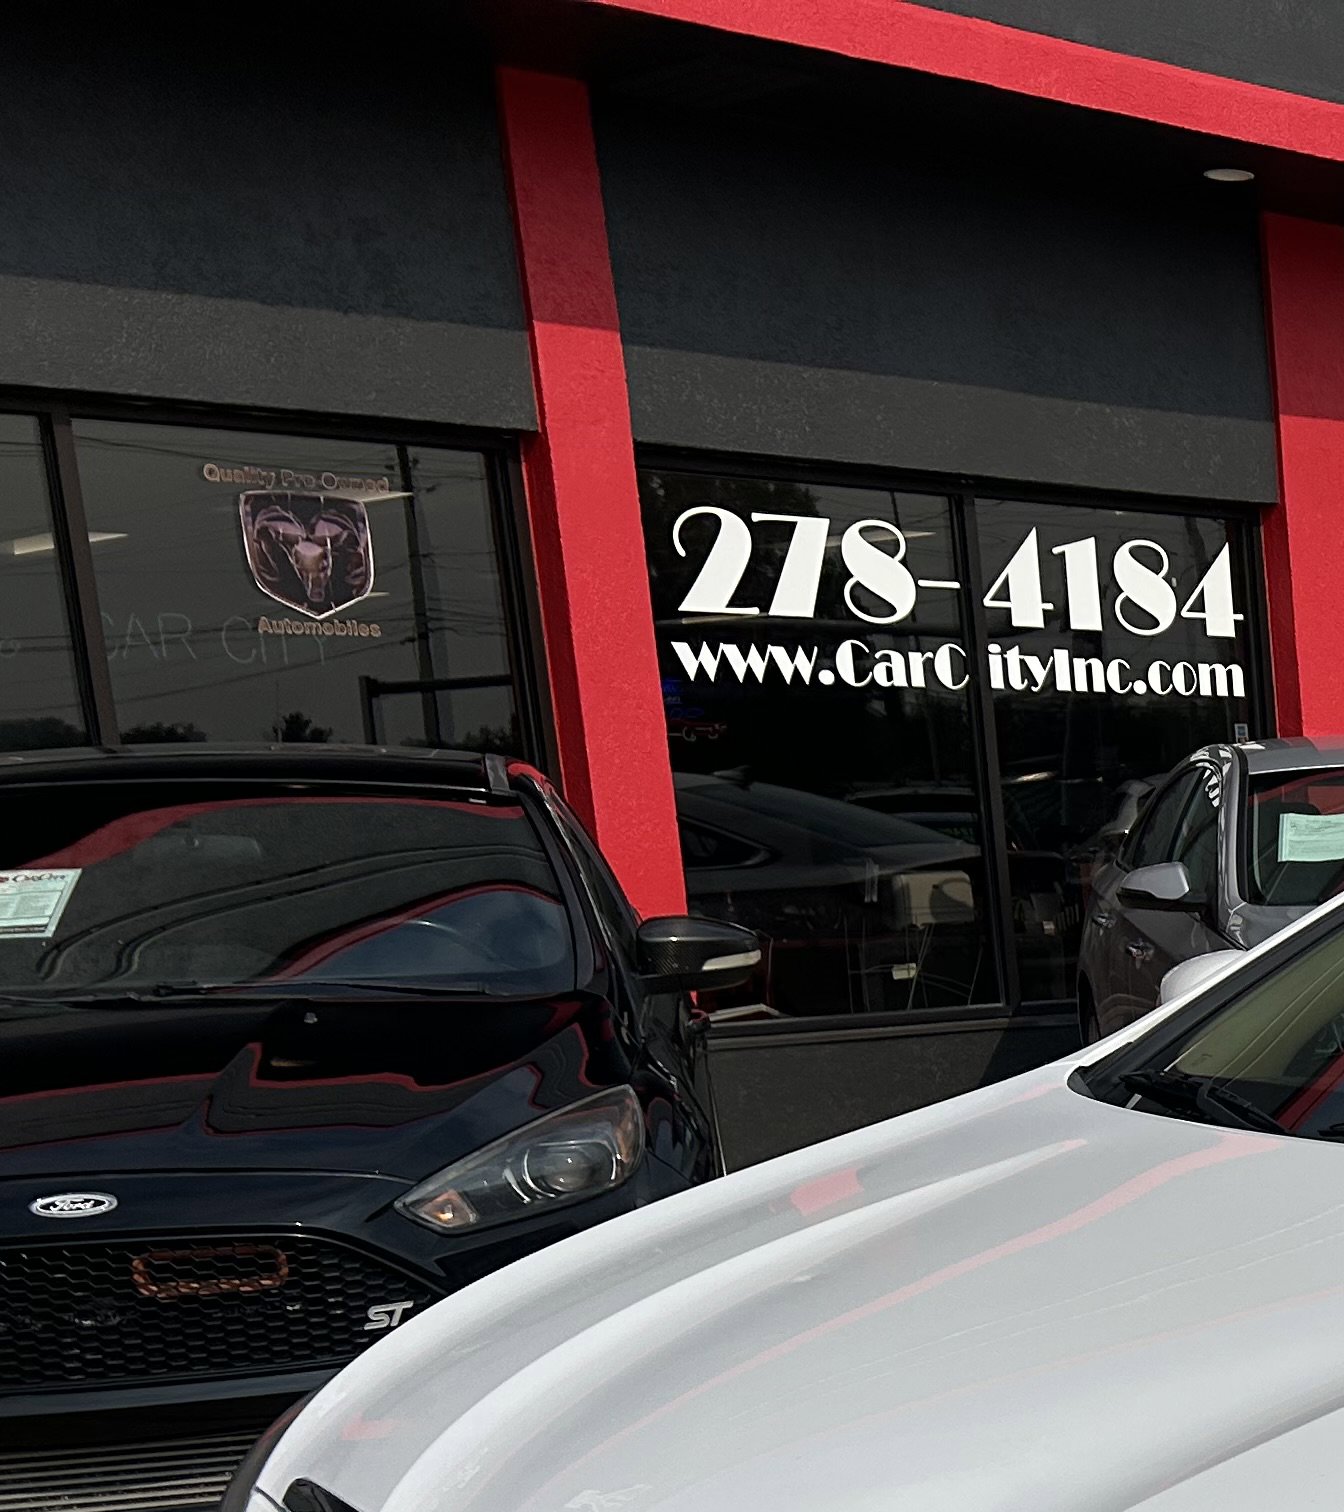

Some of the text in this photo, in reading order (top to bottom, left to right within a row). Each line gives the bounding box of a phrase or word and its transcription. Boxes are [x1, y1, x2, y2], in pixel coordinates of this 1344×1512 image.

[258, 616, 382, 638] Automobiles
[50, 1198, 95, 1211] Ford
[363, 1300, 414, 1330] ST
